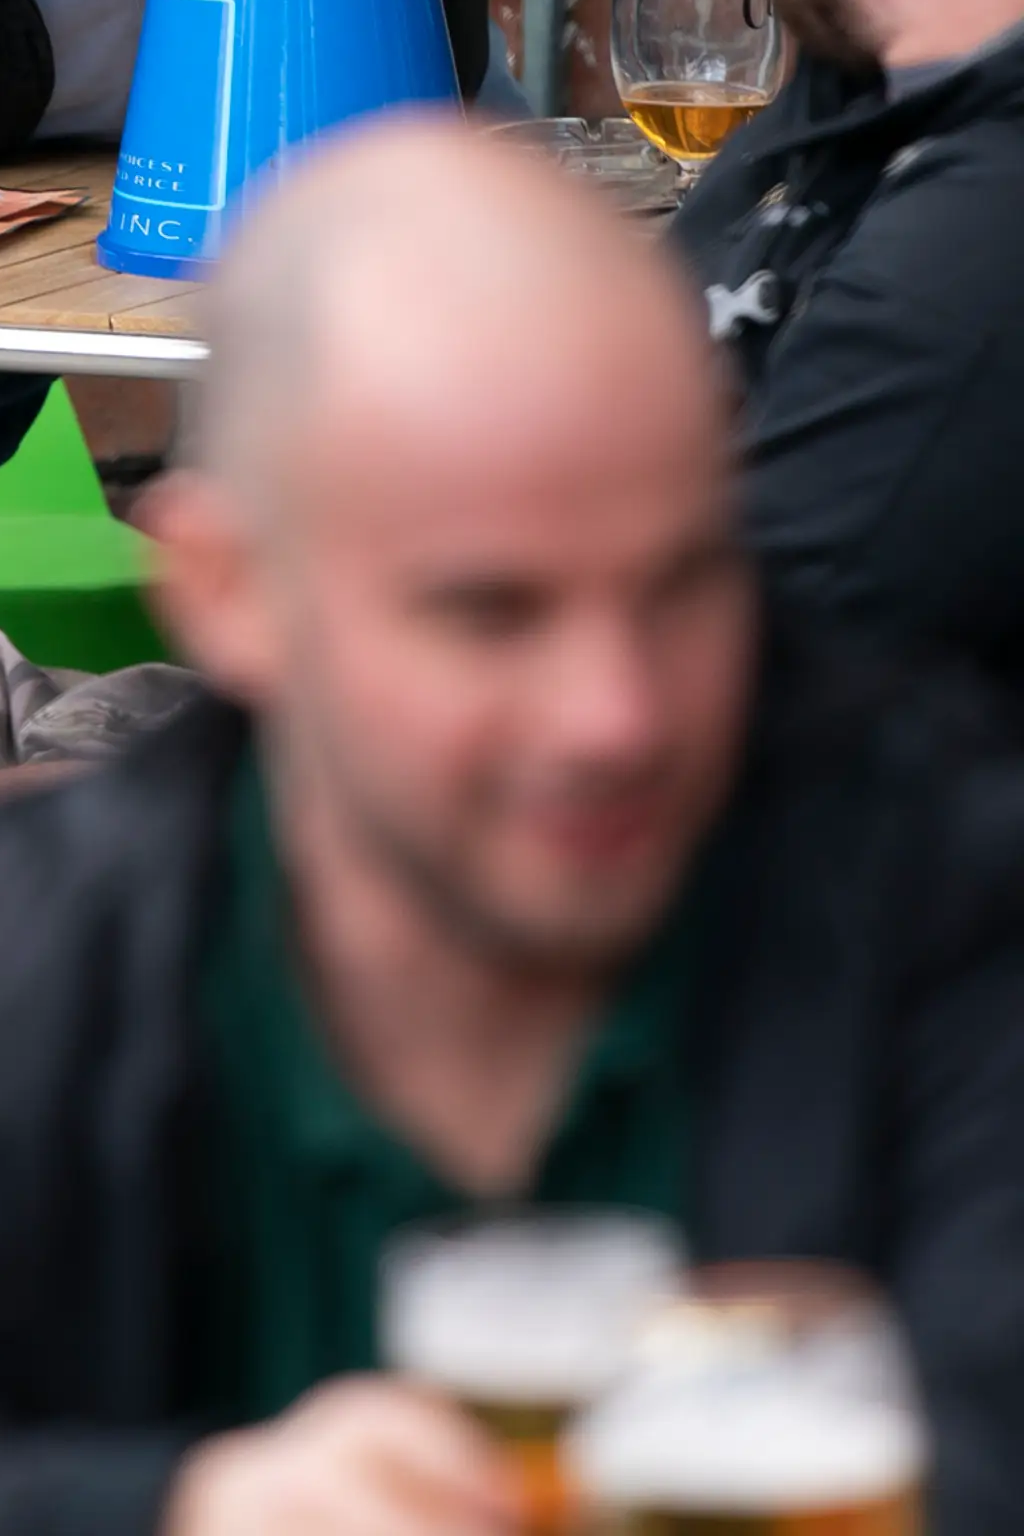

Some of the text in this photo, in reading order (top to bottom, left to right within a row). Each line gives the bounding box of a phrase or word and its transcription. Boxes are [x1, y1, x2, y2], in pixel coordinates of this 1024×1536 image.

[122, 154, 188, 174] OICEST
[134, 175, 185, 192] RICE
[120, 214, 193, 242] INC.
